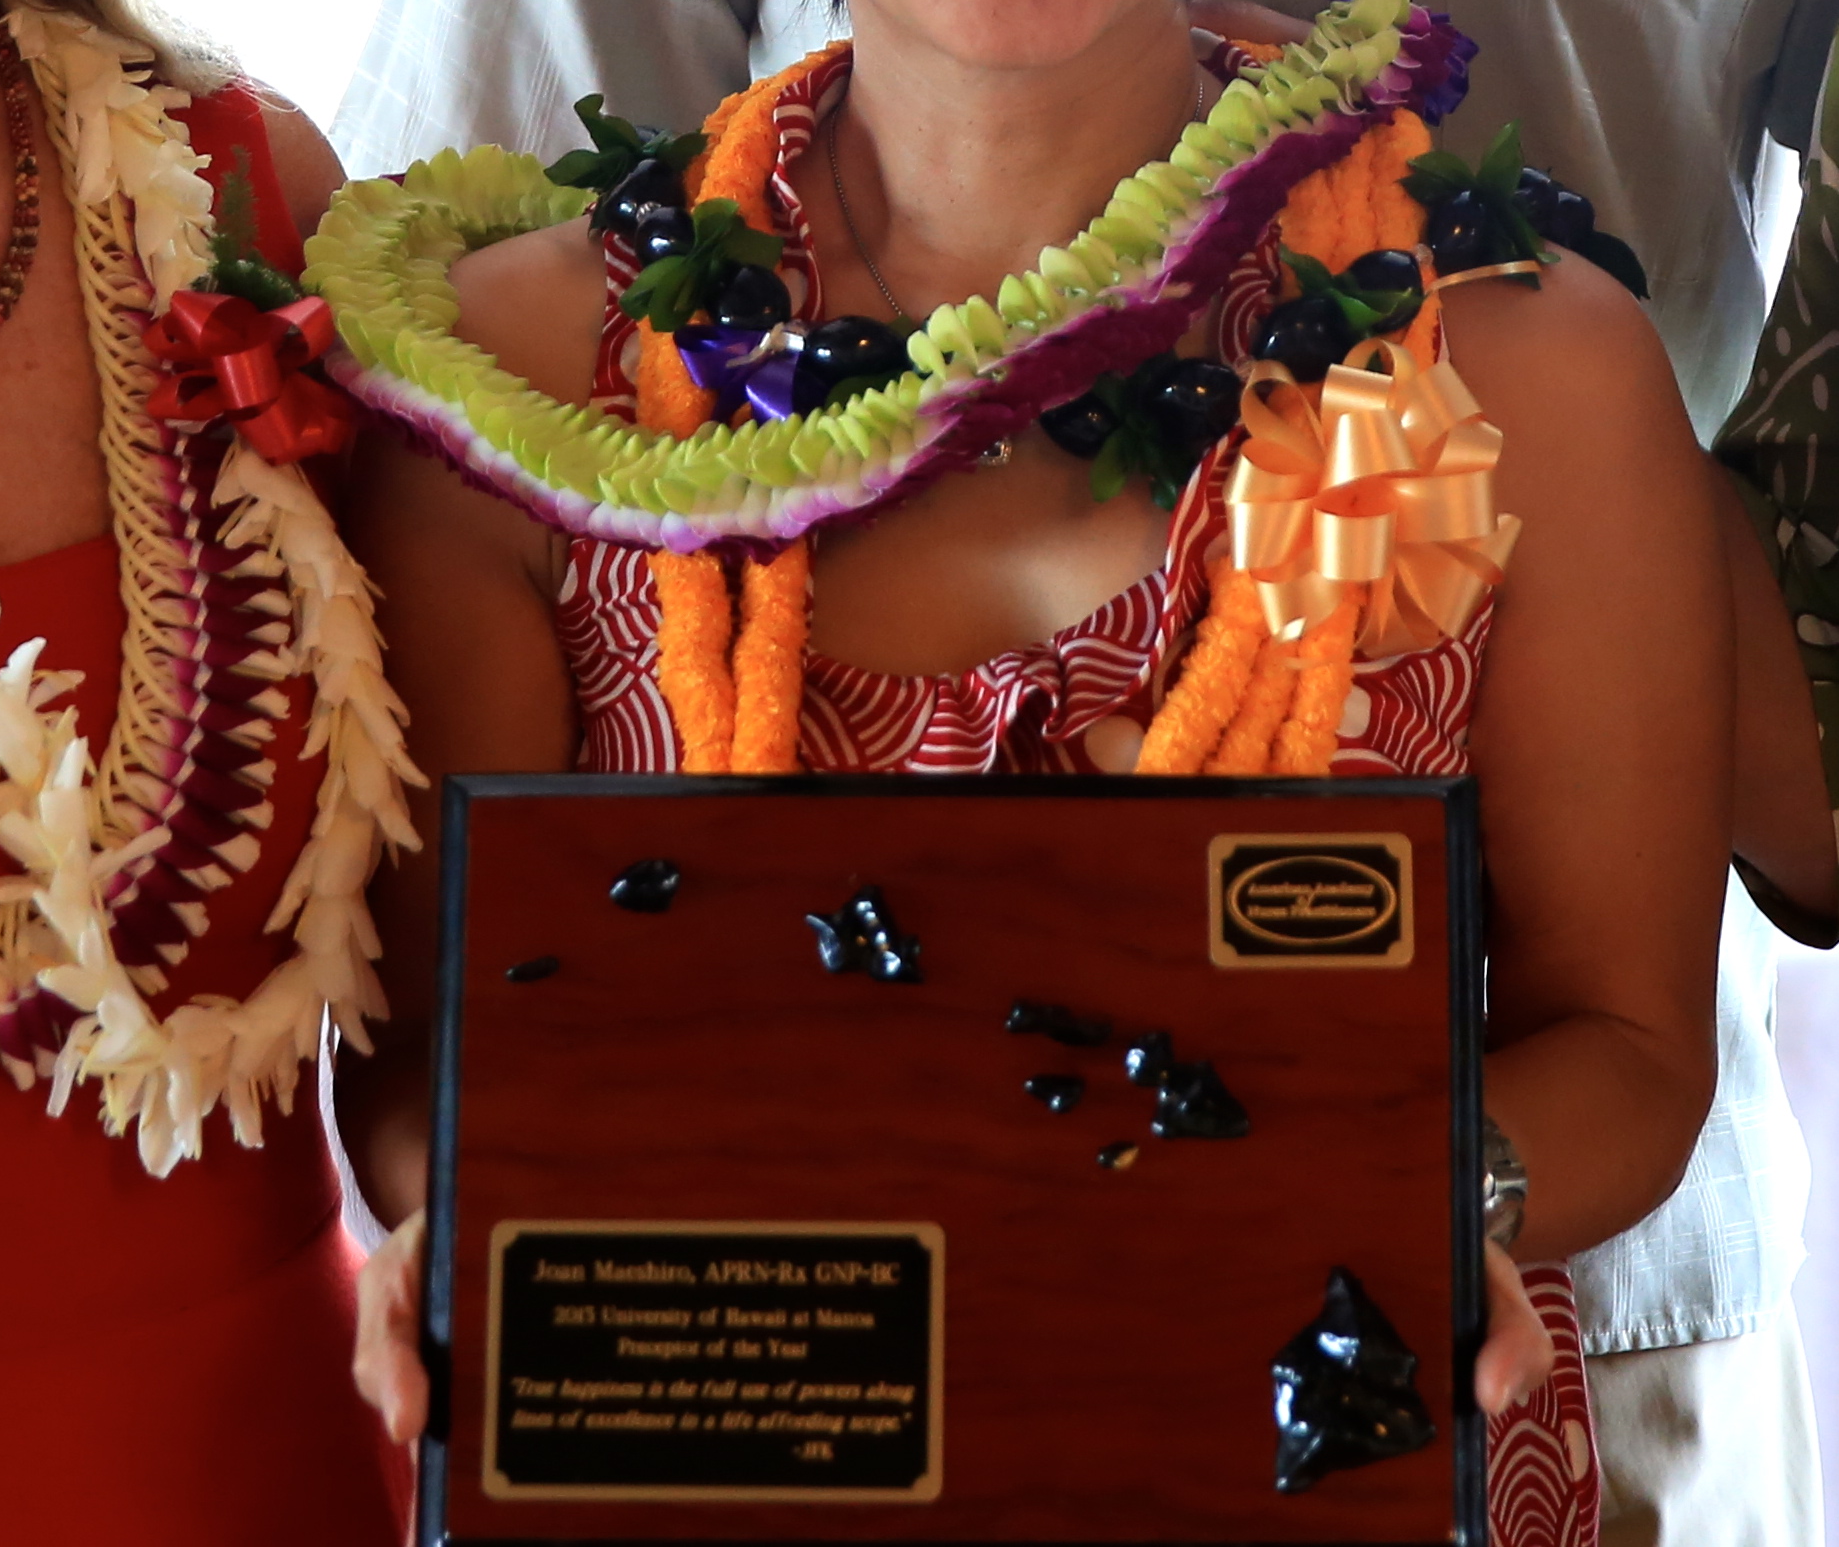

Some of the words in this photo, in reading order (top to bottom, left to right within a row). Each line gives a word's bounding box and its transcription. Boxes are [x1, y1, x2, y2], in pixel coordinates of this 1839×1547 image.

[532, 1259, 585, 1282] Joan
[594, 1260, 696, 1284] Maeshiro,
[704, 1260, 807, 1284] APRN-Rx
[814, 1261, 900, 1285] GNP-BC
[602, 1305, 692, 1329] University
[698, 1307, 718, 1326] of
[792, 1310, 809, 1326] at
[816, 1308, 875, 1328] Manoa
[618, 1337, 699, 1358] Preceptor
[706, 1338, 726, 1356] of
[733, 1338, 760, 1357] the
[768, 1339, 807, 1357] Year
[560, 1378, 644, 1400] happiness
[648, 1380, 664, 1398] is
[668, 1379, 698, 1398] the
[701, 1379, 737, 1399] full
[740, 1383, 770, 1399] use
[773, 1380, 797, 1399] of
[798, 1383, 862, 1402] powers
[865, 1381, 915, 1403] along
[512, 1409, 554, 1428] lines
[559, 1409, 583, 1428] of
[585, 1409, 675, 1430] excellence
[679, 1411, 699, 1430] in
[703, 1415, 715, 1430] a
[721, 1410, 754, 1430] life
[757, 1410, 845, 1434] affording
